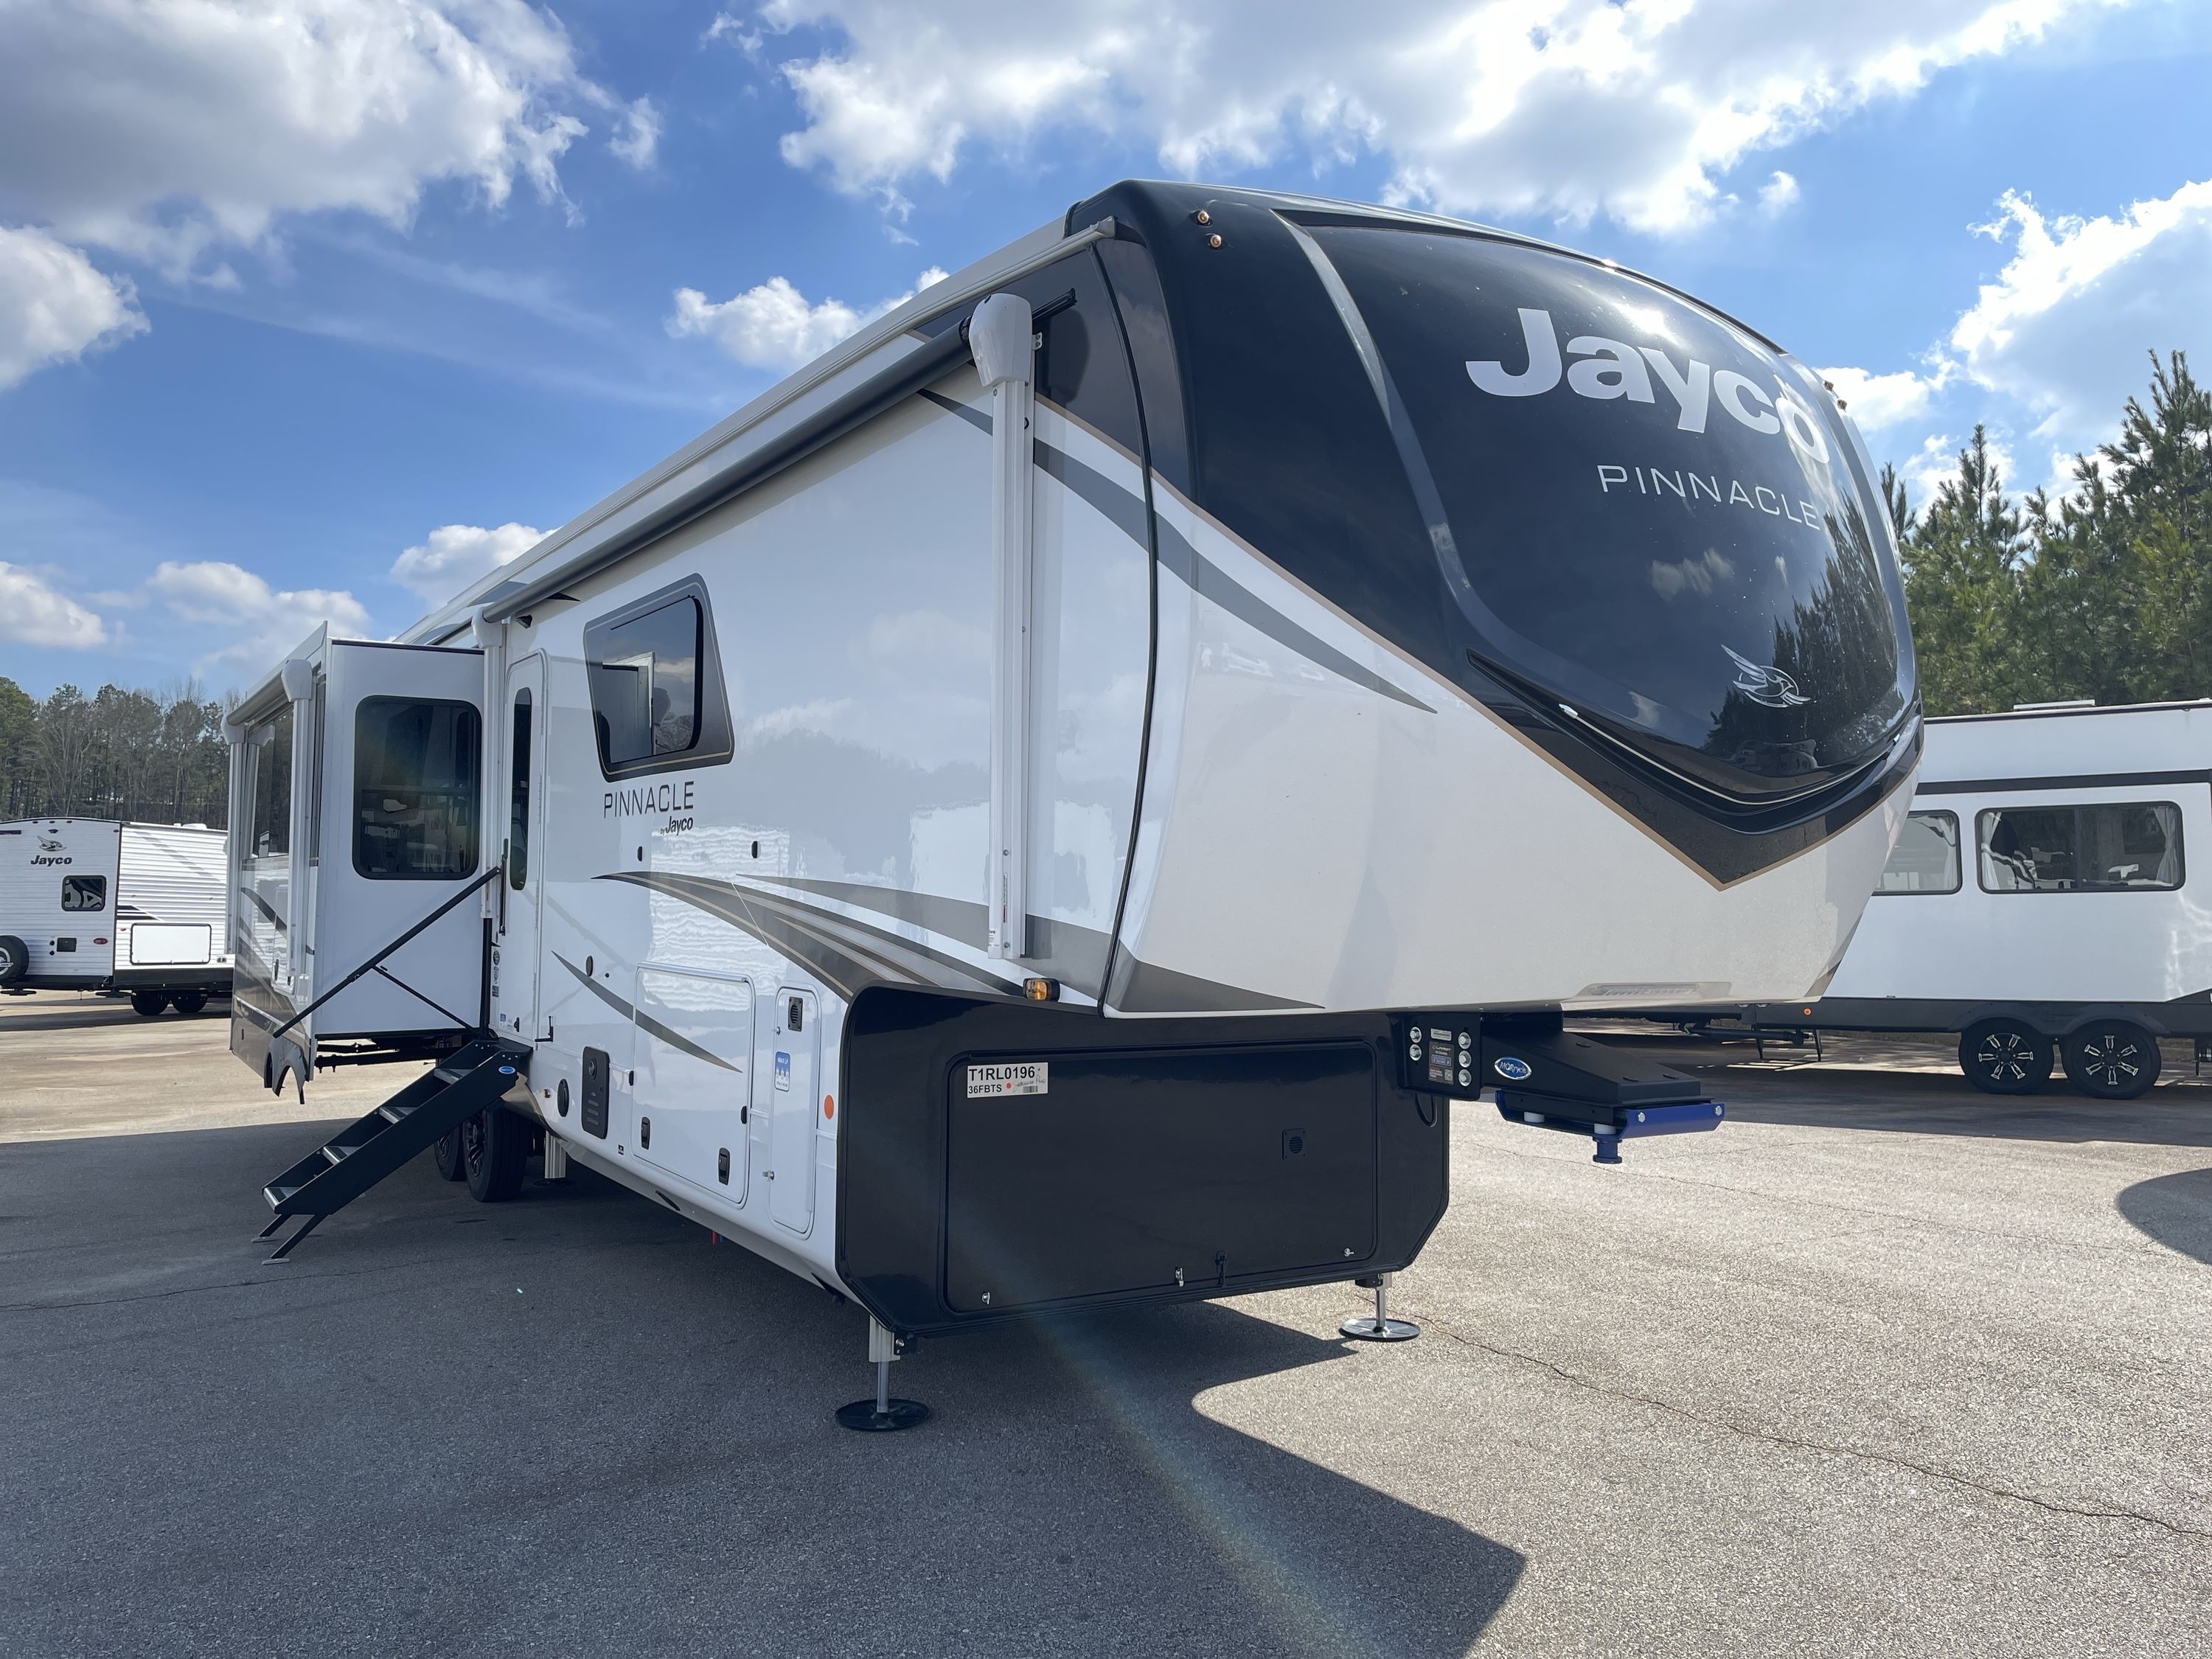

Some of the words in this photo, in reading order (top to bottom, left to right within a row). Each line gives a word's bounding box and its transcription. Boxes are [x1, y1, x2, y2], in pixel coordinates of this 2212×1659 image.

[1465, 307, 1830, 465] Jayco
[1597, 464, 1820, 531] PINNACLE
[604, 780, 695, 818] PINNACLE
[665, 815, 693, 836] Jayco
[30, 855, 72, 867] Jayco
[969, 1066, 1035, 1081] T1RL0196
[968, 1084, 1002, 1094] 36FBTS
